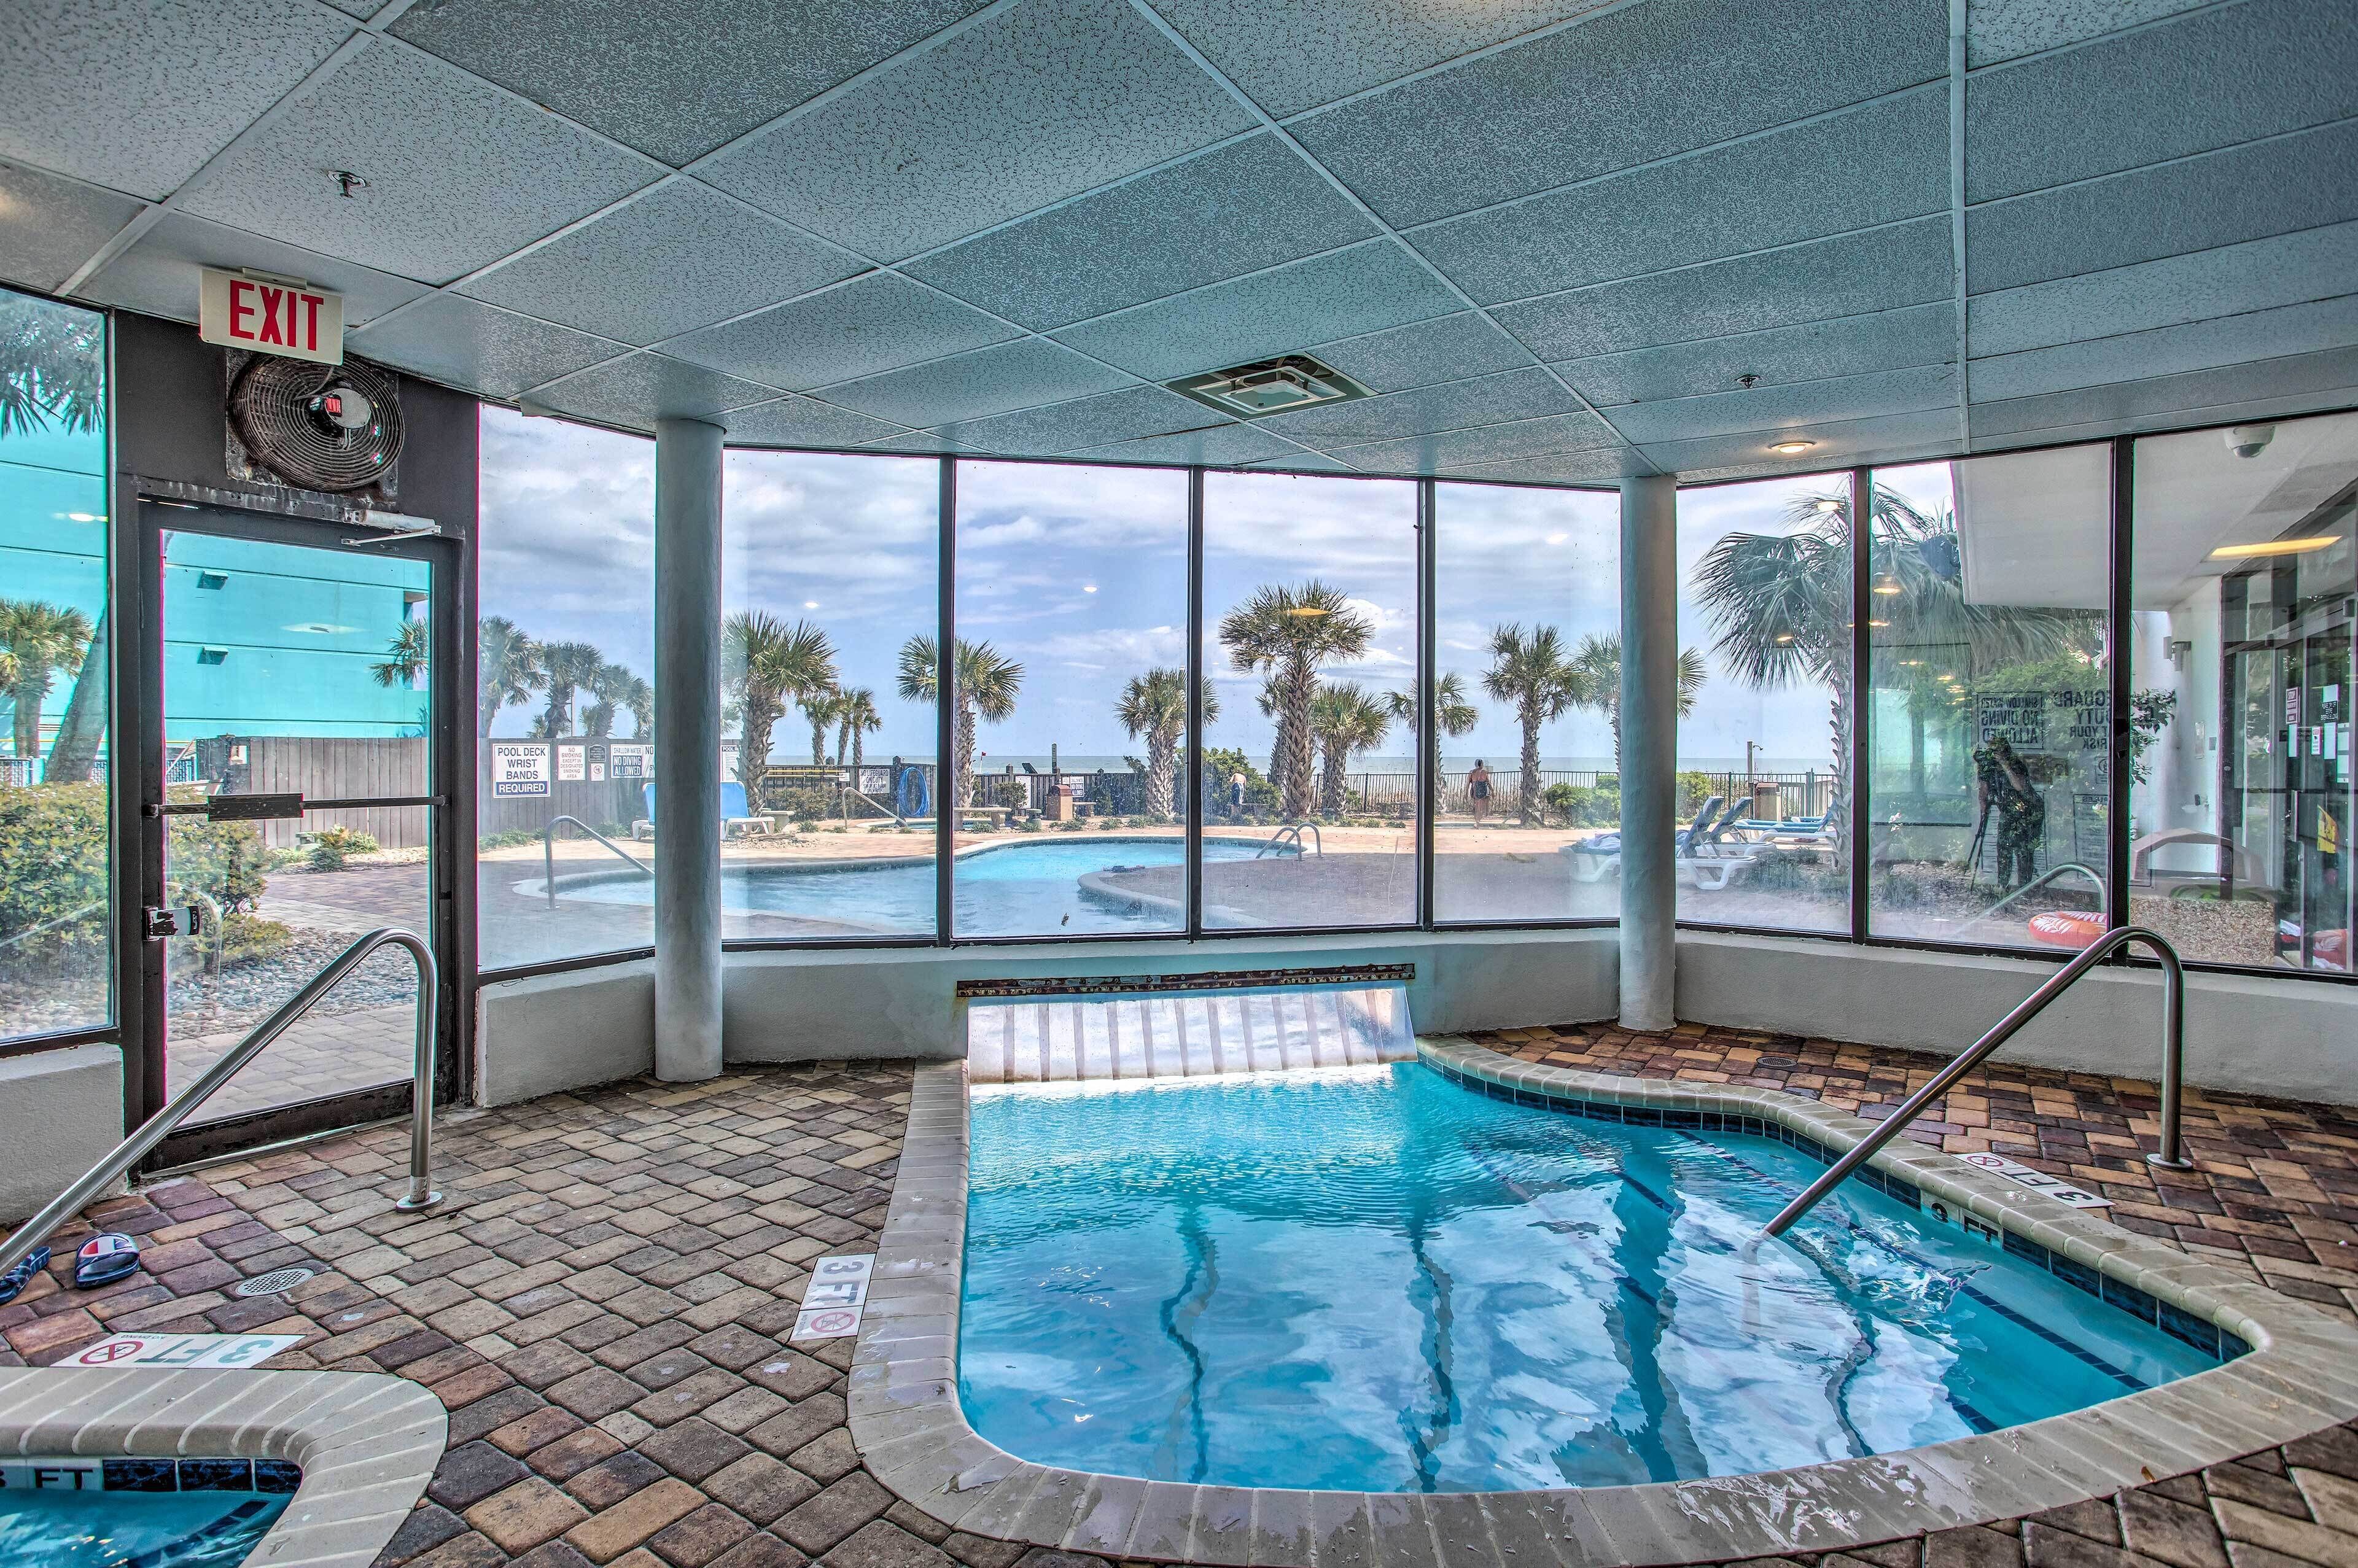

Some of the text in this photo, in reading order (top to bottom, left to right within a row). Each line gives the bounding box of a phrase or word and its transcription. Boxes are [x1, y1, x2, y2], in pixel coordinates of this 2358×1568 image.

[230, 279, 324, 351] EXIT
[498, 747, 546, 756] POOL DECK
[645, 746, 654, 755] NO
[507, 759, 537, 768] WRIST
[613, 756, 642, 766] NO DIVING
[506, 770, 539, 780] BANDS
[615, 766, 641, 775] ALLOWED
[499, 783, 545, 793] REQUIRED
[1999, 1171, 2093, 1201] 3 FT
[811, 1260, 865, 1304] 3 FT
[133, 1338, 274, 1364] 3 FT
[34, 1468, 94, 1490] FT
